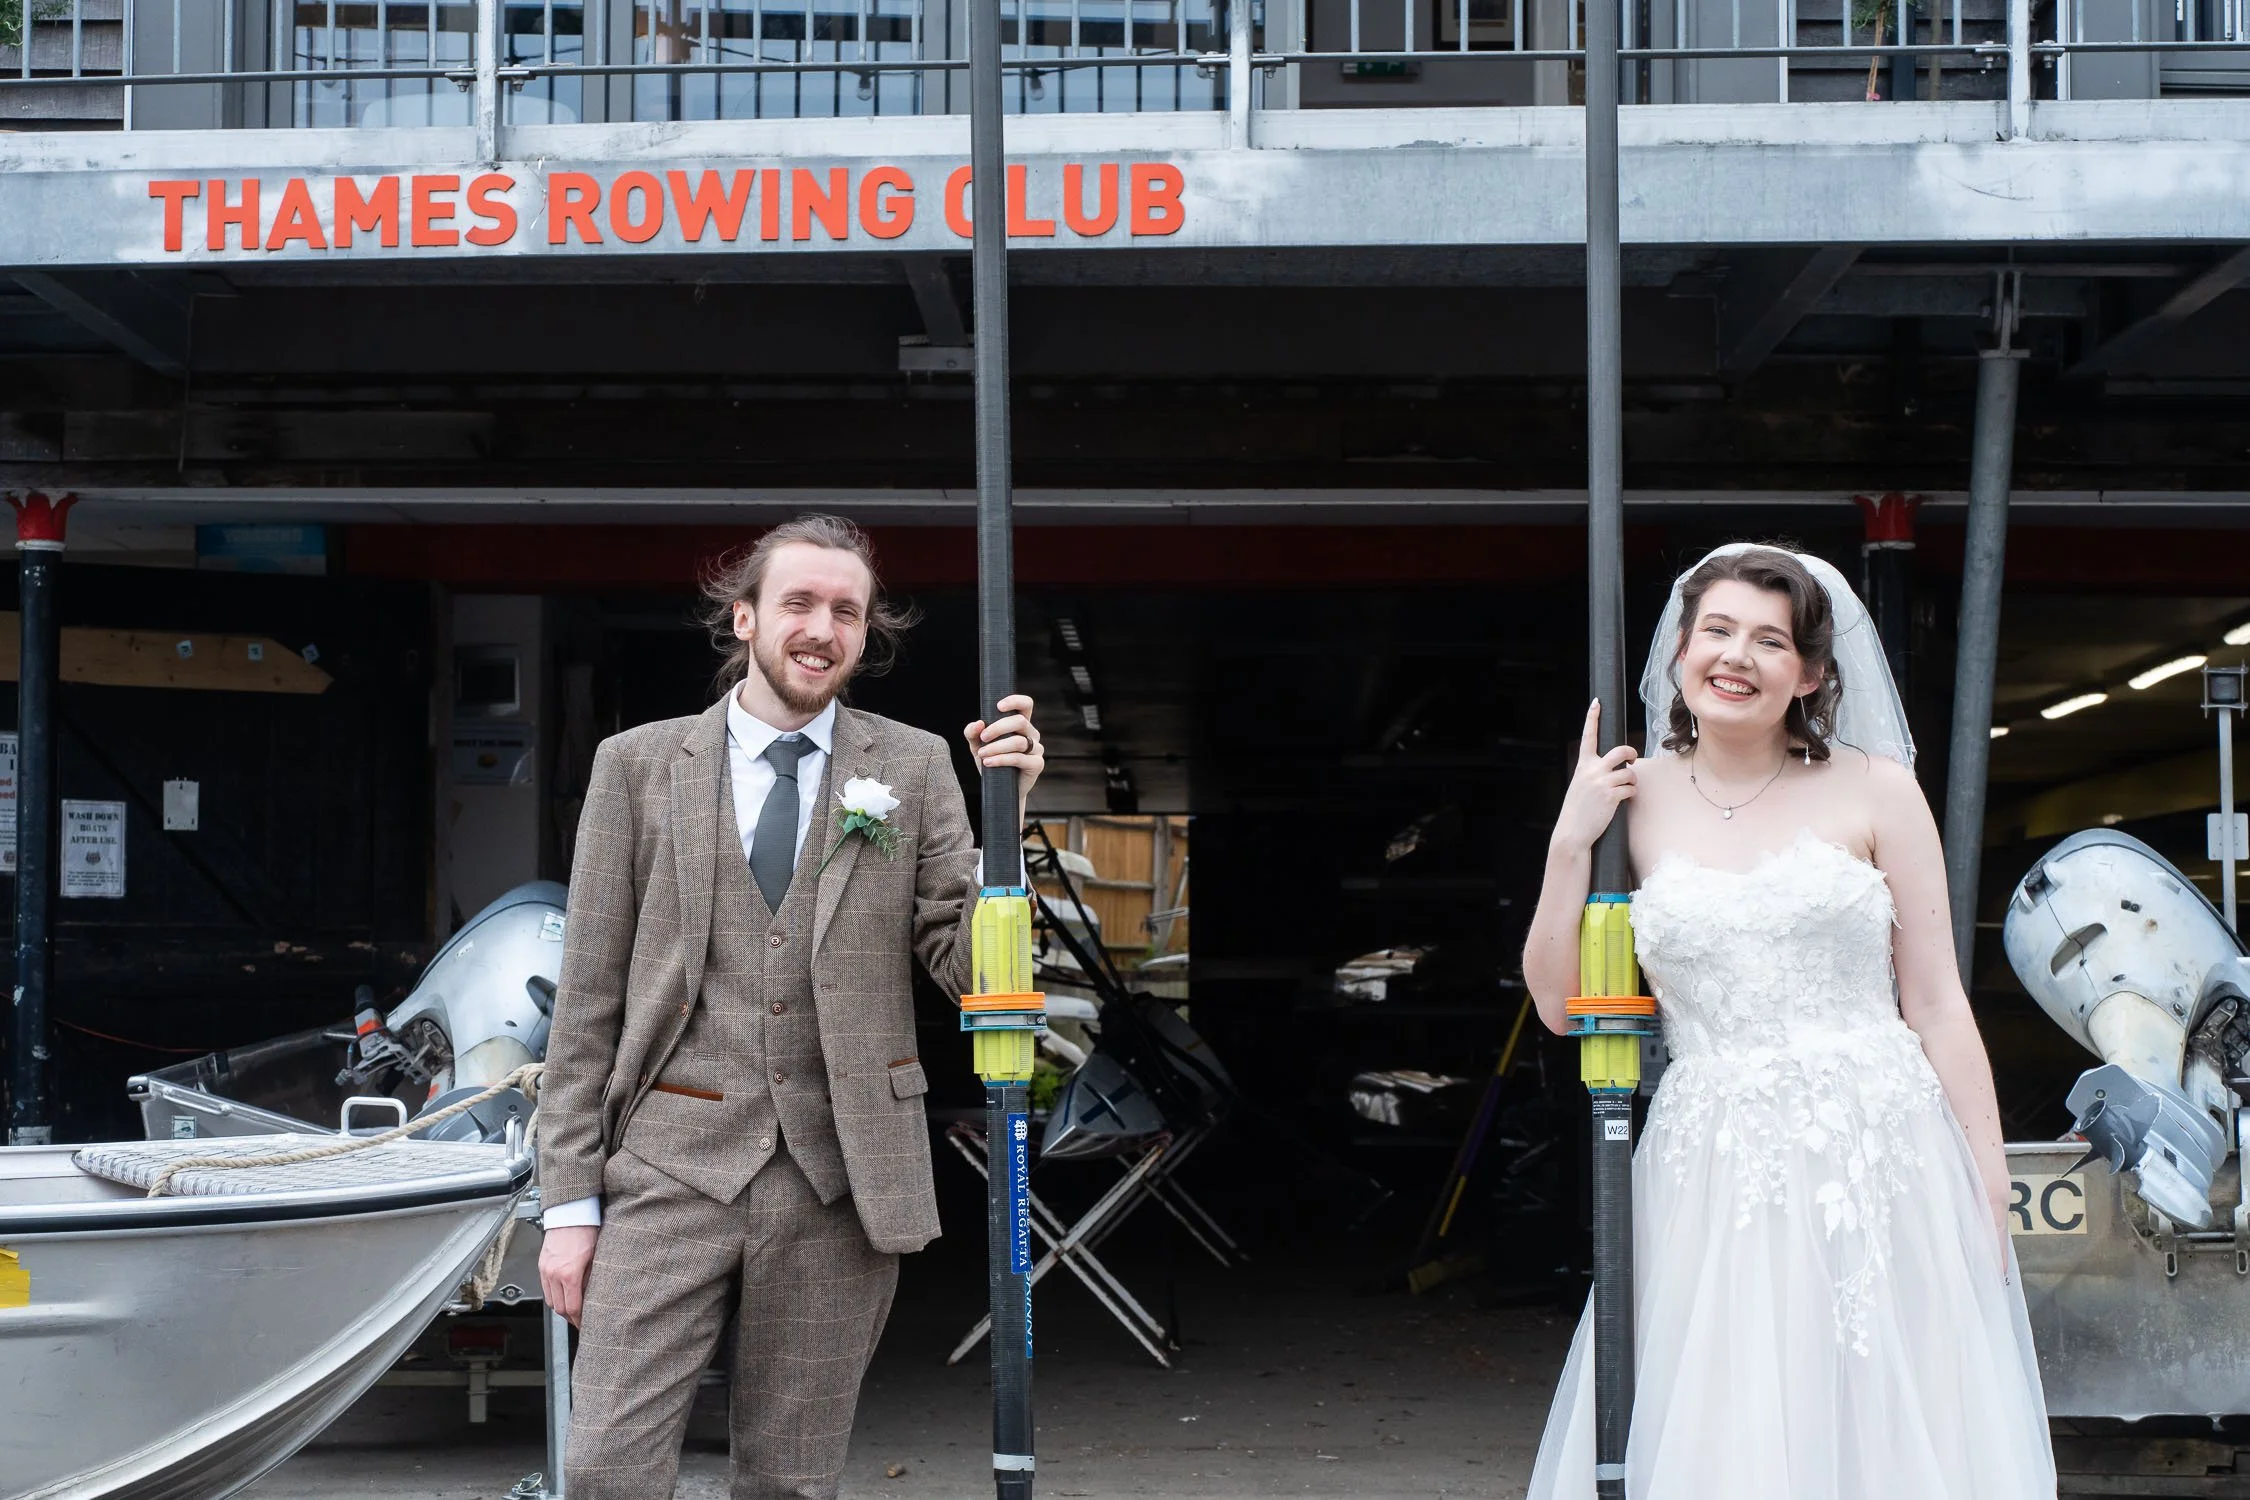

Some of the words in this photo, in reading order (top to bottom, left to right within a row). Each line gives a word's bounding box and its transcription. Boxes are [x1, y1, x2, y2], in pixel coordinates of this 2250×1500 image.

[149, 173, 518, 251] THAMES
[547, 167, 916, 246] ROWING
[68, 811, 93, 820] WASH
[95, 811, 119, 821] DOWN
[80, 823, 108, 832] BOATS
[70, 835, 98, 844] AFTER
[1607, 1125, 1629, 1135] W22
[1016, 1144, 1026, 1193] ROYAL
[1017, 1198, 1028, 1268] REGATTA
